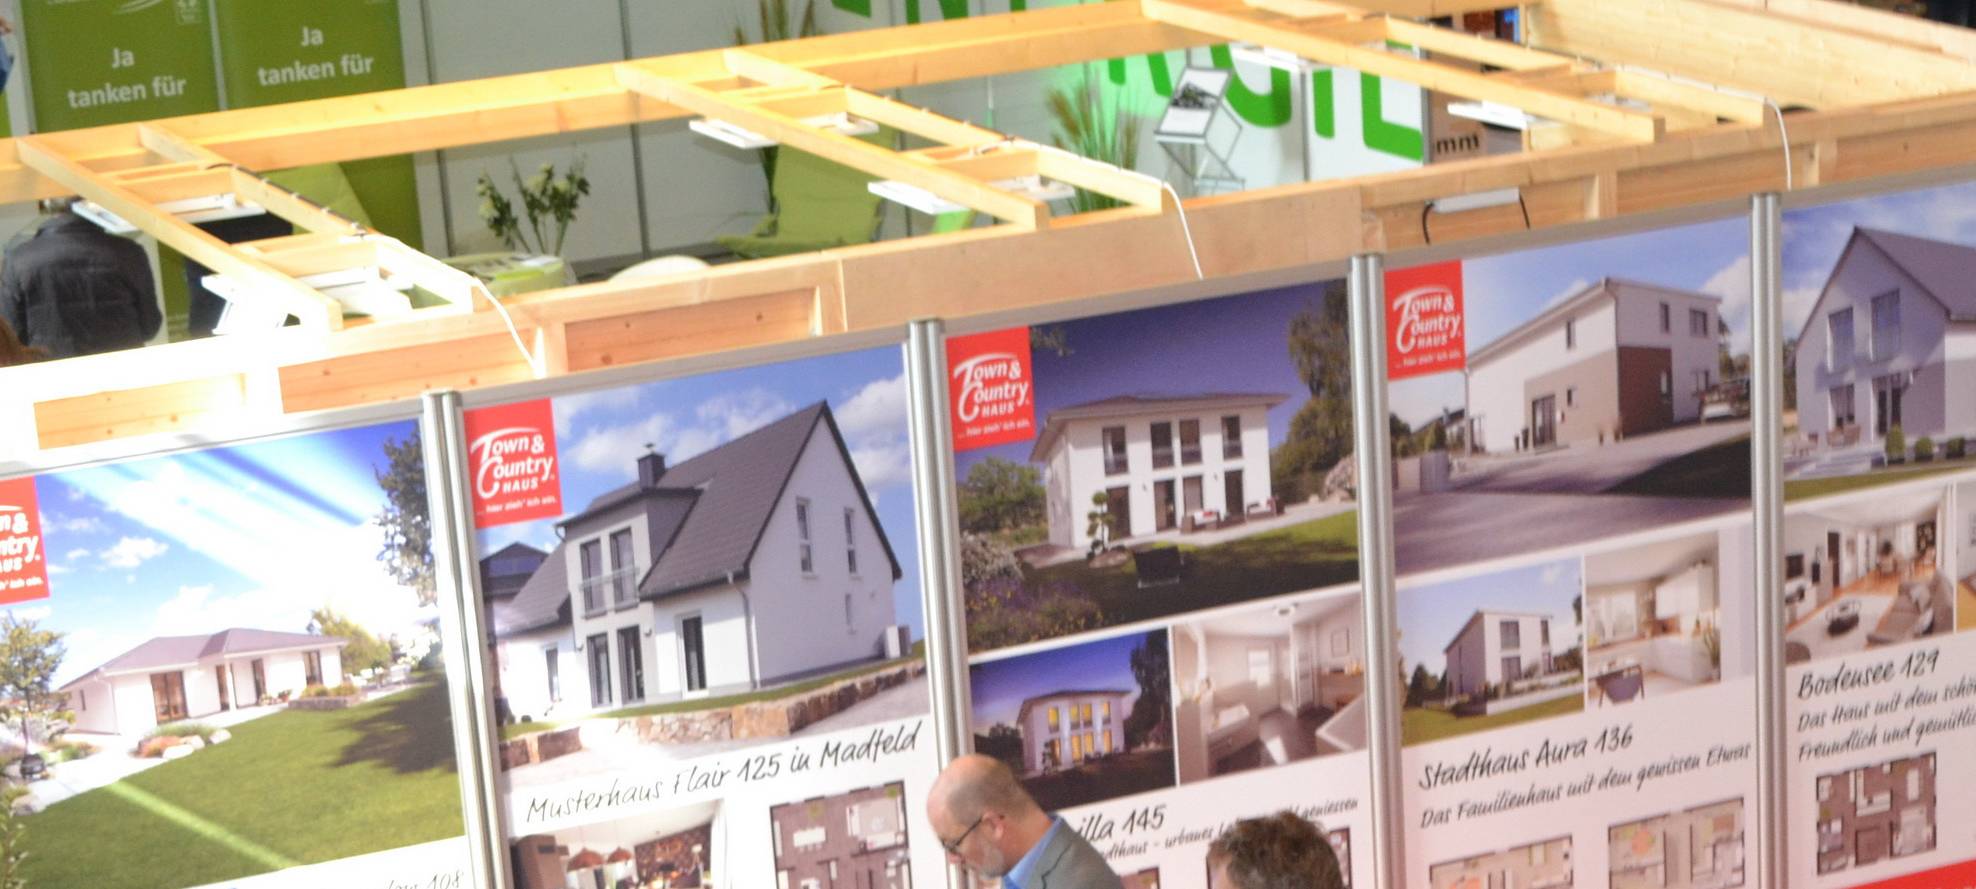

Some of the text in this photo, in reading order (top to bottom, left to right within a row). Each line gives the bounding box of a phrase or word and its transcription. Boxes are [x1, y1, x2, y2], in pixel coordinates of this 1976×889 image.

[301, 26, 324, 46] Ja
[111, 47, 135, 68] Ja
[257, 54, 375, 86] tanken für
[67, 75, 187, 108] tanken für
[1393, 286, 1451, 321] Town
[1396, 314, 1461, 354] Country
[954, 353, 1021, 387] Town &
[958, 381, 1028, 423] Country
[981, 401, 1014, 418] HAUS
[470, 427, 545, 465] Town &
[477, 456, 553, 499] Country
[502, 476, 538, 493] HAUS
[1798, 648, 1940, 699] Bodensee 129
[1798, 711, 1828, 732] Das
[1832, 701, 1871, 725] Haus
[1874, 692, 1902, 715] mit
[1904, 684, 1938, 710] dem
[1418, 722, 1634, 790] Stadthaus Aura 136
[1798, 724, 1878, 762] Freundlich
[1882, 716, 1915, 744] und
[526, 720, 923, 823] Musterhaus Flair 125 in Madfeld
[1420, 743, 1752, 829] Das Familienhaus mit dem gewissen Etwas
[1078, 803, 1168, 842] illa 145
